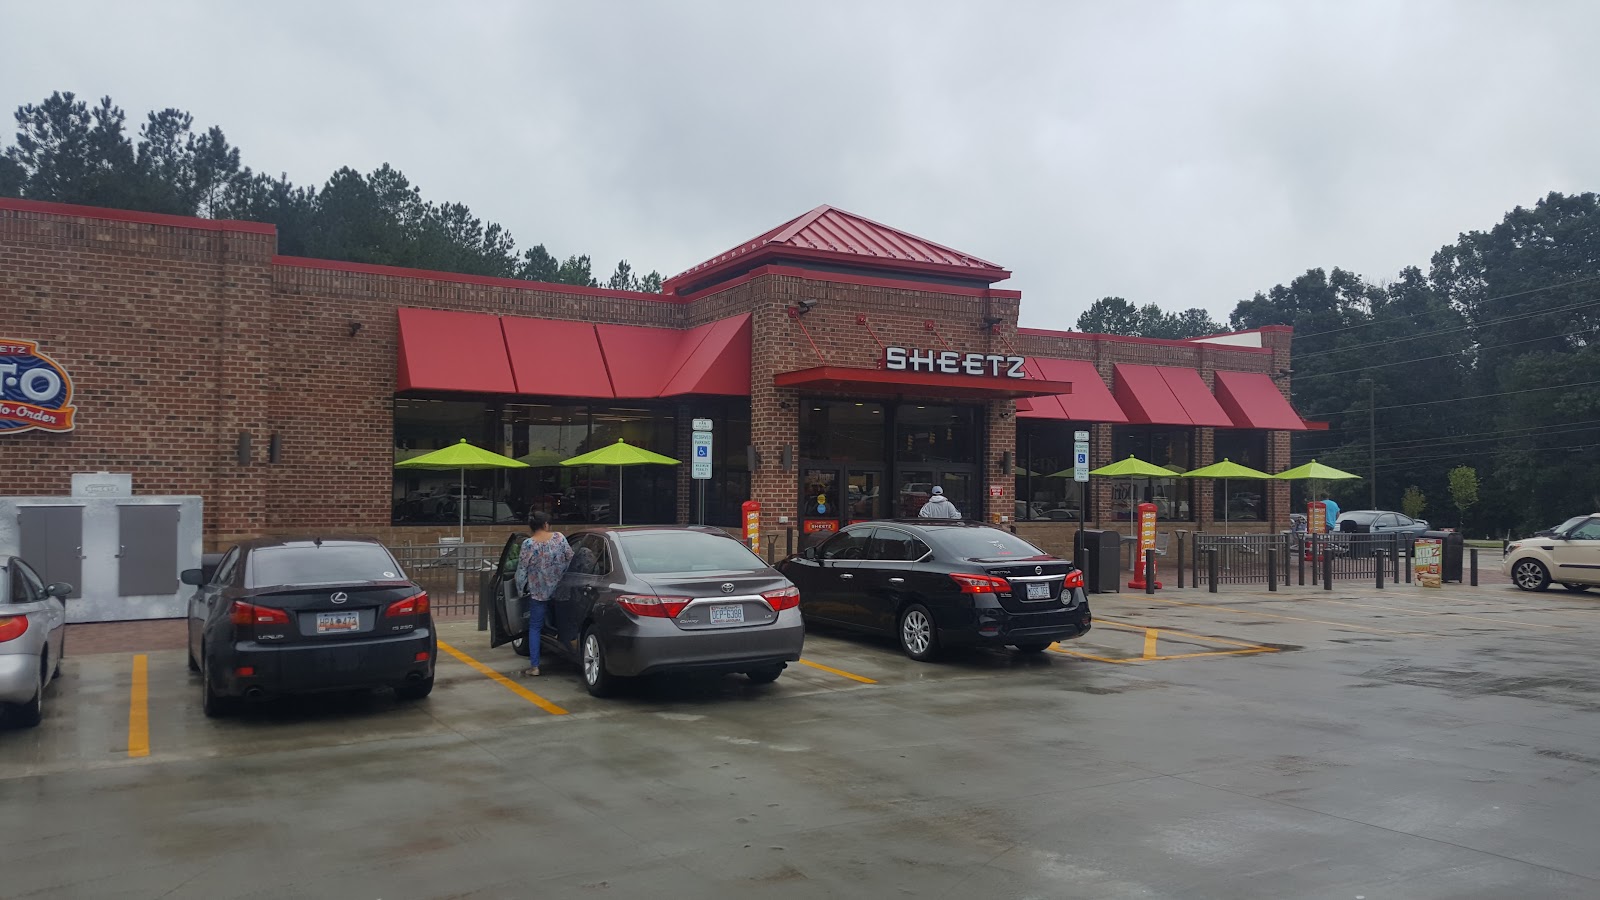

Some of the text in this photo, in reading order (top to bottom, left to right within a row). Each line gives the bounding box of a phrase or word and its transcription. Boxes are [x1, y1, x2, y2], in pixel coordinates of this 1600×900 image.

[886, 347, 1025, 378] SHEETZ
[0, 403, 57, 424] o-Order
[1415, 556, 1440, 566] MENU
[1416, 547, 1441, 559] KIDZ
